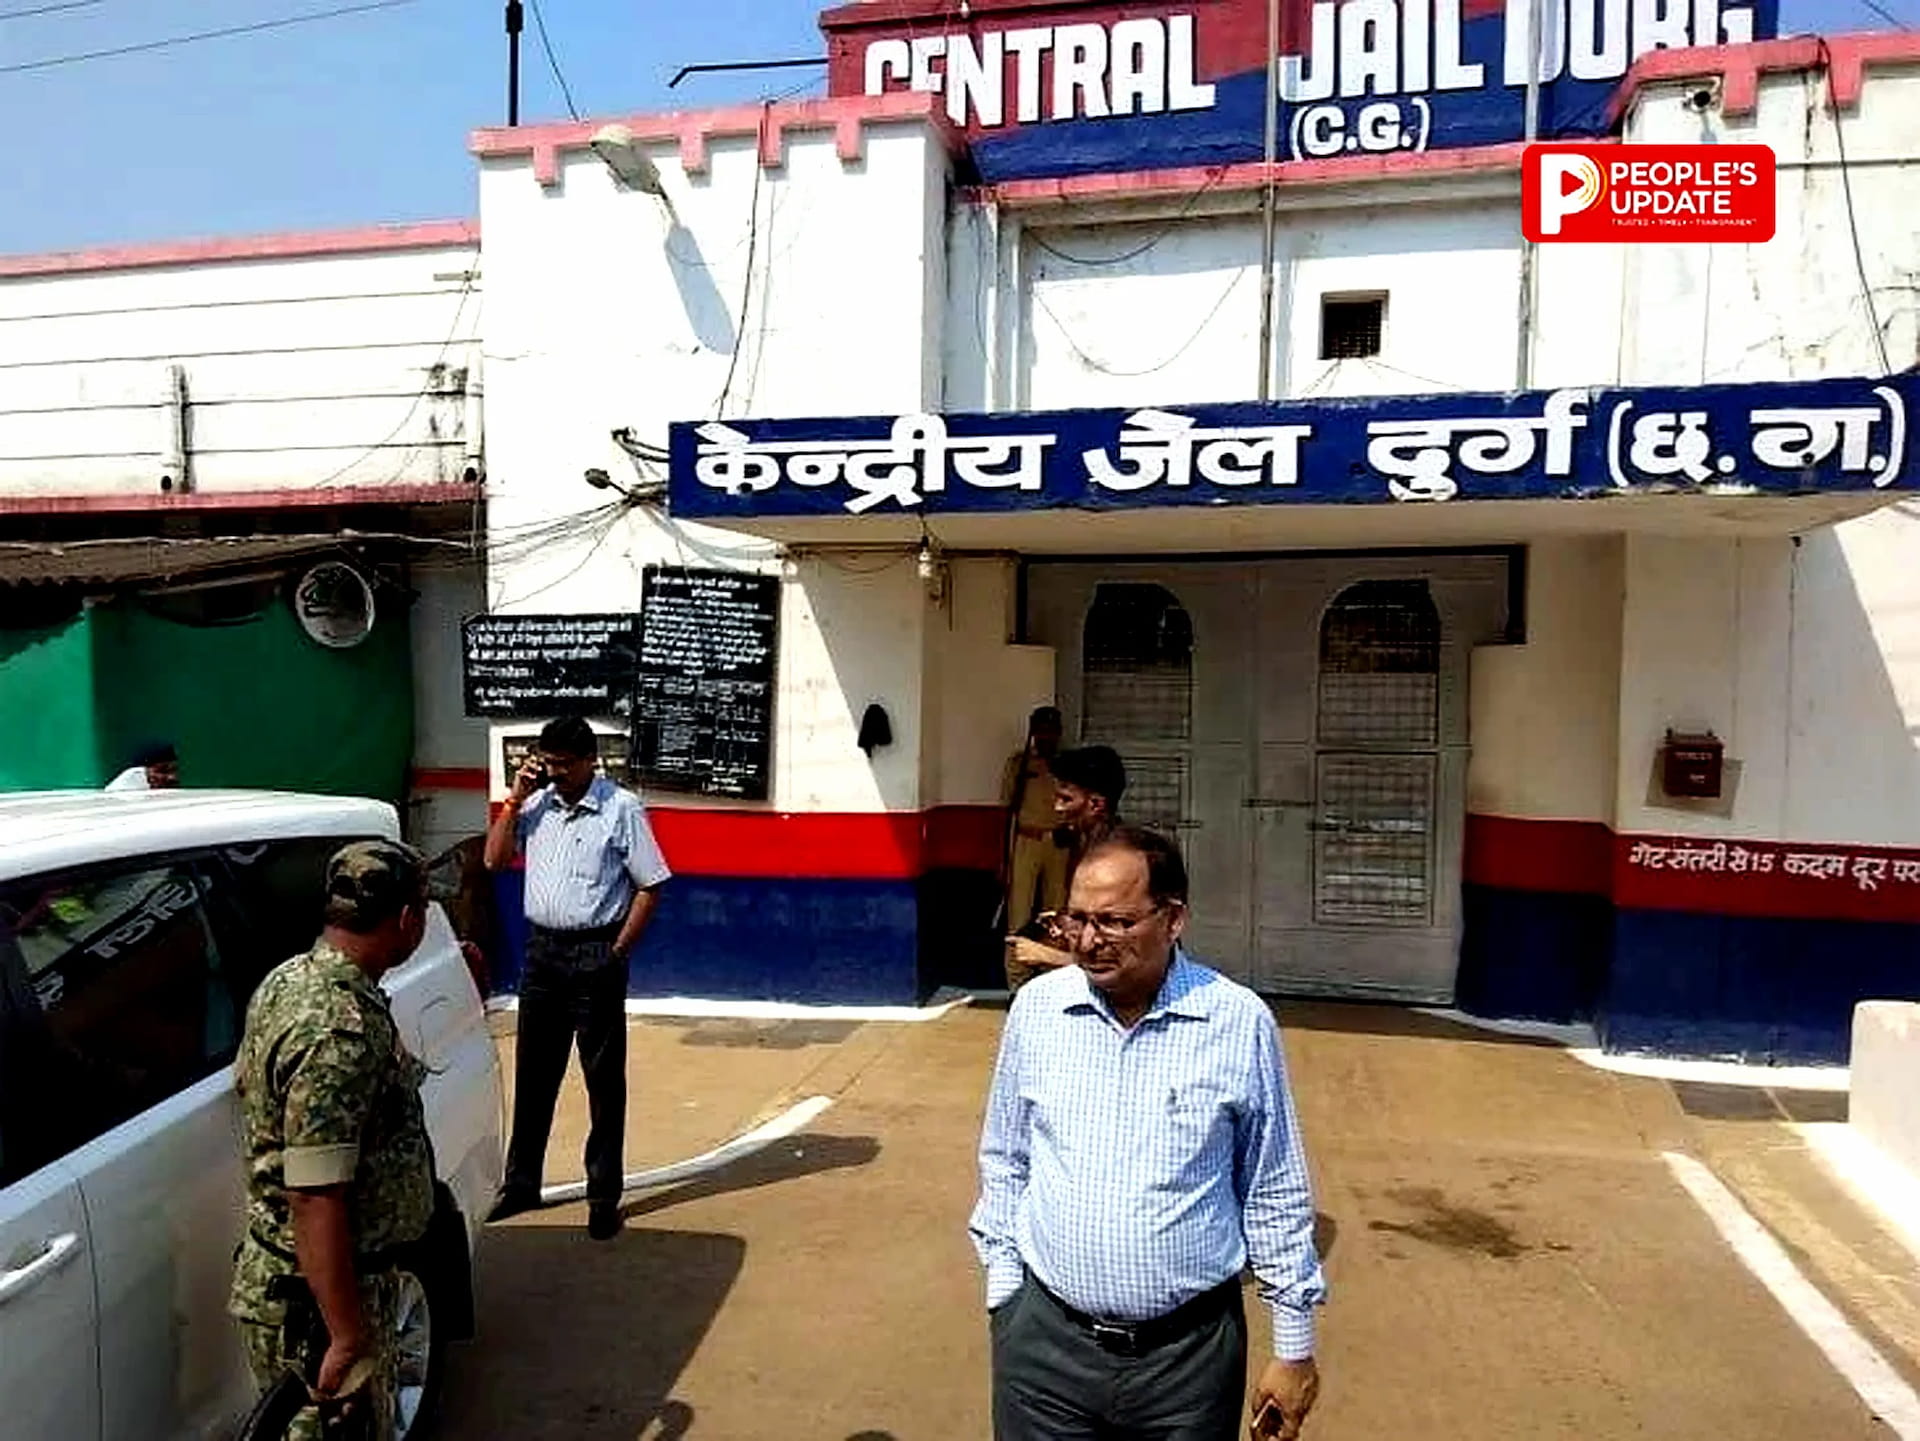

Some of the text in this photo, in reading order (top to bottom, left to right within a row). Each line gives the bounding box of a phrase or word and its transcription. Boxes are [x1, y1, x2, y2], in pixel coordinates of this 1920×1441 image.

[865, 15, 1216, 127] CENTRAL
[1279, 0, 1484, 101] JAIL
[1287, 98, 1430, 161] (C.G.)
[694, 413, 1056, 514] केन्द्रीय
[1082, 409, 1312, 491] जेल
[1367, 388, 1588, 500] दुर्ग
[1752, 853, 1776, 872] 15
[1783, 854, 1849, 879] कदम
[1851, 857, 1889, 890] दूर
